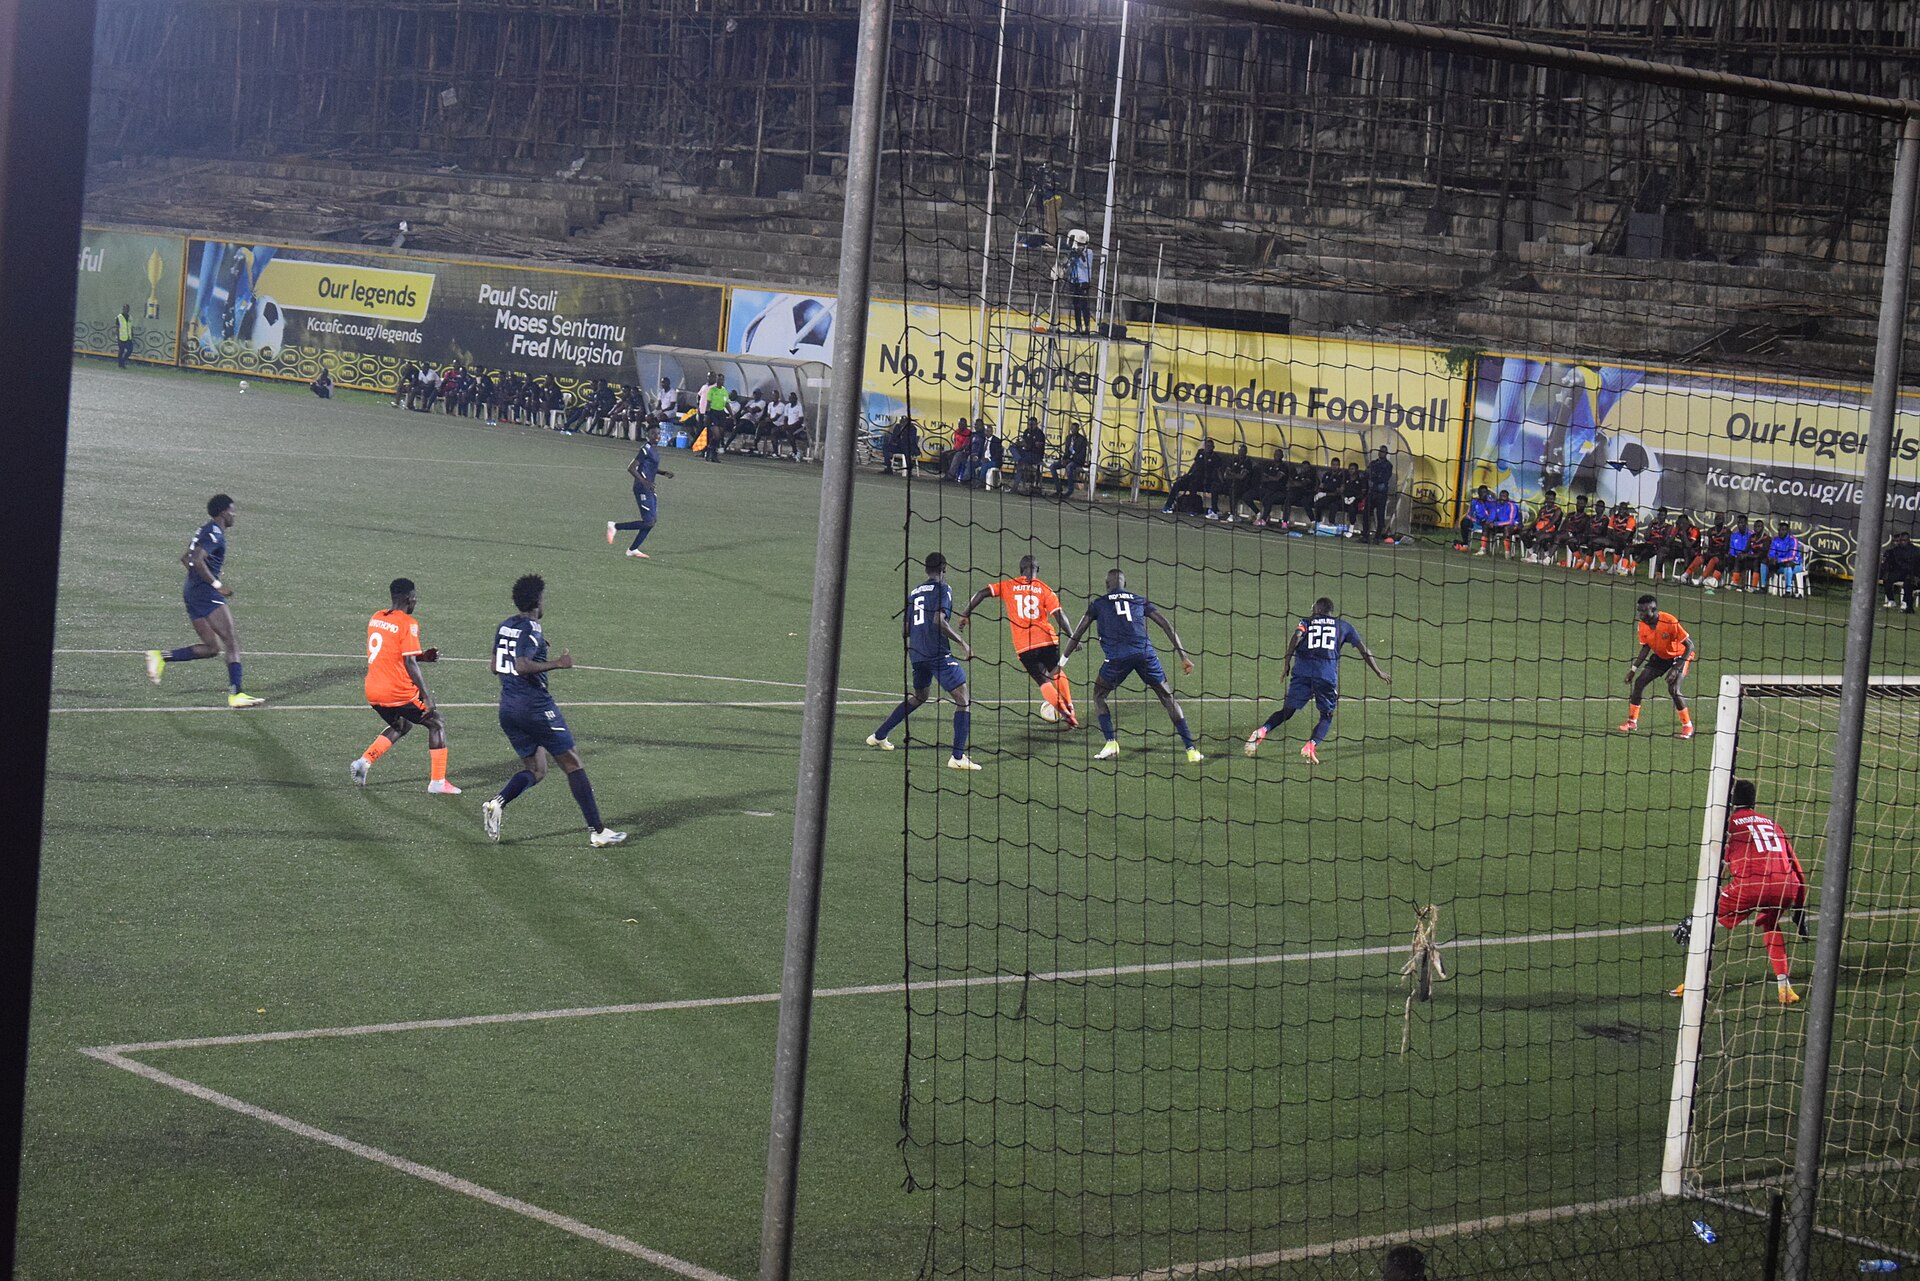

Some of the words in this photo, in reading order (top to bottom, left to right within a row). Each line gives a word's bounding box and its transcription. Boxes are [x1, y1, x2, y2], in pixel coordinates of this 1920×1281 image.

[79, 246, 104, 272] ful
[318, 277, 349, 299] Our
[351, 280, 416, 308] legends
[478, 284, 516, 307] Paul
[517, 288, 558, 311] Ssali
[307, 317, 423, 344] Kccafc.co.ug/legends
[494, 309, 548, 334] Moses
[550, 314, 626, 342] Sentamu
[511, 334, 551, 358] Fred
[552, 338, 624, 368] Mugisha
[1112, 368, 1142, 400] of
[1307, 386, 1448, 433] Football
[1726, 412, 1786, 444] Our
[1818, 538, 1840, 550] MTN
[914, 596, 925, 626] 5
[1014, 594, 1040, 620] 18
[1114, 600, 1133, 622] 4
[368, 632, 383, 664] 9
[1308, 625, 1336, 650] 22
[1746, 824, 1783, 854] 16
